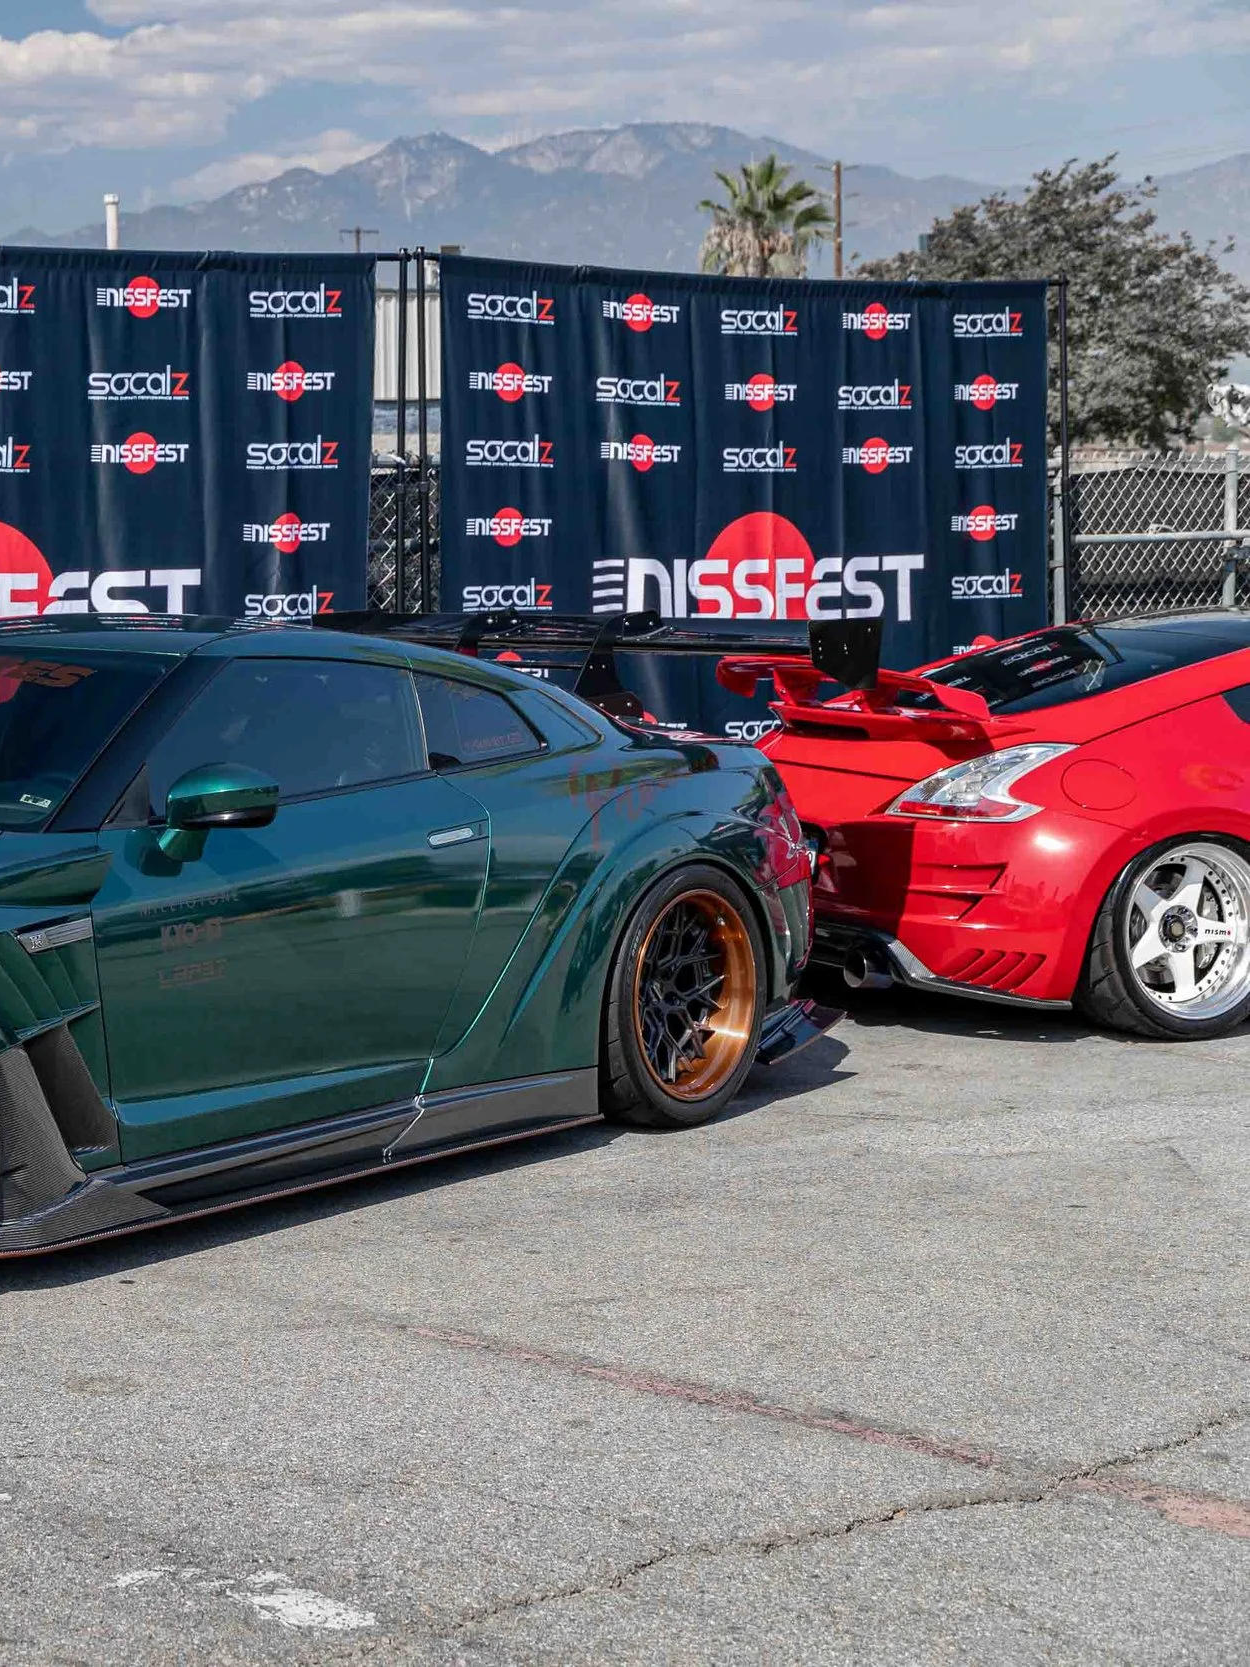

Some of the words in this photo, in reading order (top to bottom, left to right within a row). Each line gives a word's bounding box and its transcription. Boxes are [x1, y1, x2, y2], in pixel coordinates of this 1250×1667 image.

[105, 287, 191, 308] NISSFEST
[610, 301, 680, 323] NISSFEST
[847, 313, 911, 330] NISSFEST
[256, 372, 335, 391] NISSFEST
[477, 372, 552, 393] NISSFEST
[732, 384, 797, 401] NISSFEST
[958, 384, 1018, 400] NISSFEST
[101, 443, 189, 464] NISSFEST
[610, 442, 681, 463] NISSFEST
[847, 446, 913, 464] NISSFEST
[251, 523, 330, 543] NISSFEST
[475, 518, 552, 536] NISSFEST
[627, 554, 924, 621] NISSFEST
